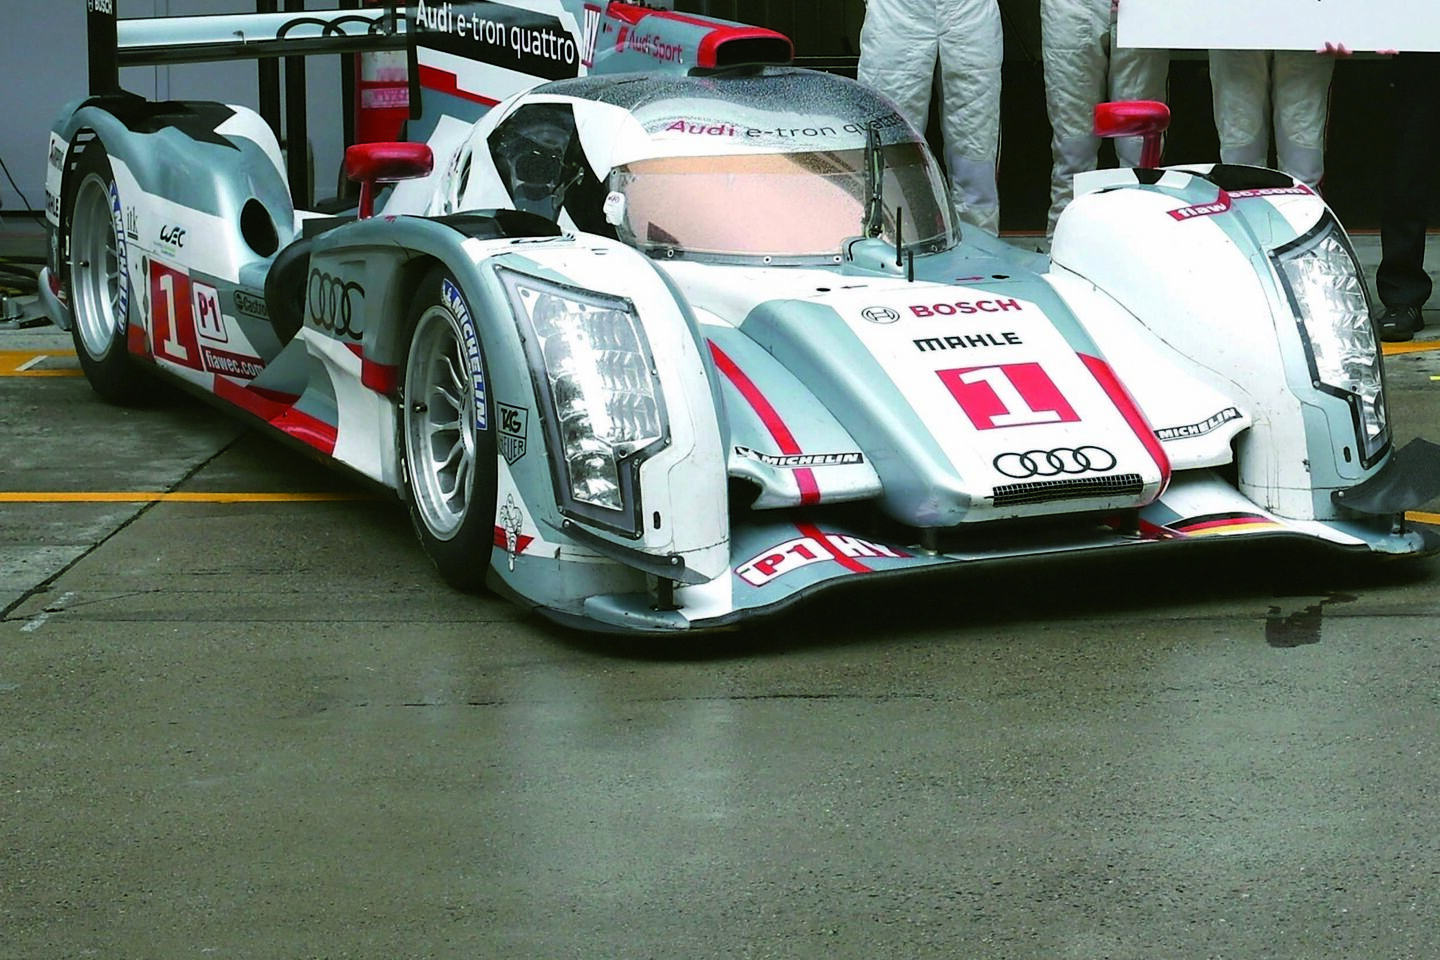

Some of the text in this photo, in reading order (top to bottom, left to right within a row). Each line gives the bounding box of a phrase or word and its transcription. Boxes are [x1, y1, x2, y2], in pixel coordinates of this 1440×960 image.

[457, 11, 506, 46] e-tron
[510, 26, 575, 65] quattro
[628, 30, 683, 64] Audi Sport
[665, 120, 736, 137] Audi
[745, 122, 836, 138] e-tron
[115, 208, 129, 334] MICHELIN
[159, 273, 188, 361] 1
[197, 290, 221, 332] P1
[243, 296, 268, 317] Castro
[909, 299, 1022, 317] BOSCH
[913, 332, 1023, 352] MAHLE
[206, 350, 265, 376] fiawec.com
[452, 296, 487, 429] MICHELIN
[958, 365, 1062, 427] 1
[500, 407, 521, 433] TAG
[1158, 408, 1236, 439] MICHELIN
[761, 453, 860, 466] MICHELIN
[753, 544, 817, 576] P1
